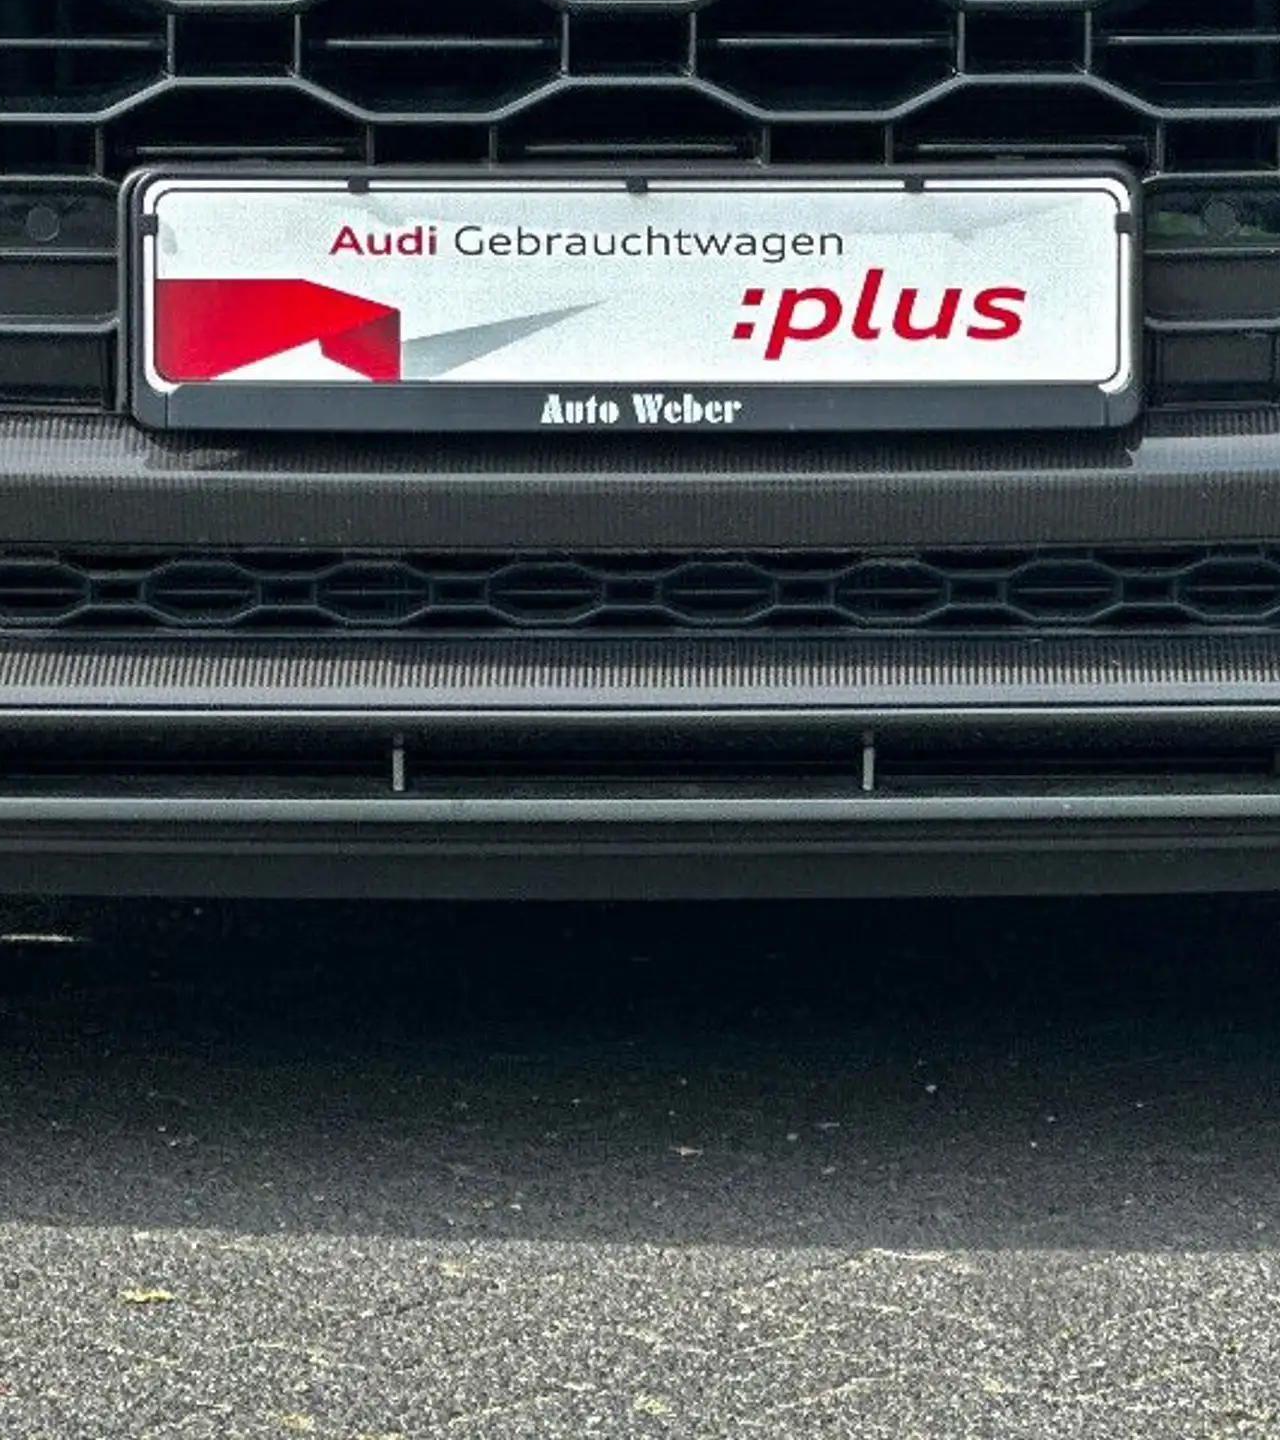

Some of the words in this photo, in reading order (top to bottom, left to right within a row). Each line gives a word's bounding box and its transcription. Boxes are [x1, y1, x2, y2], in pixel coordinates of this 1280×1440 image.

[328, 224, 439, 257] Audi
[453, 224, 845, 263] Gebrauchtwagen
[732, 267, 1028, 361] :plus
[539, 392, 620, 425] Auto
[631, 392, 743, 425] Weber
